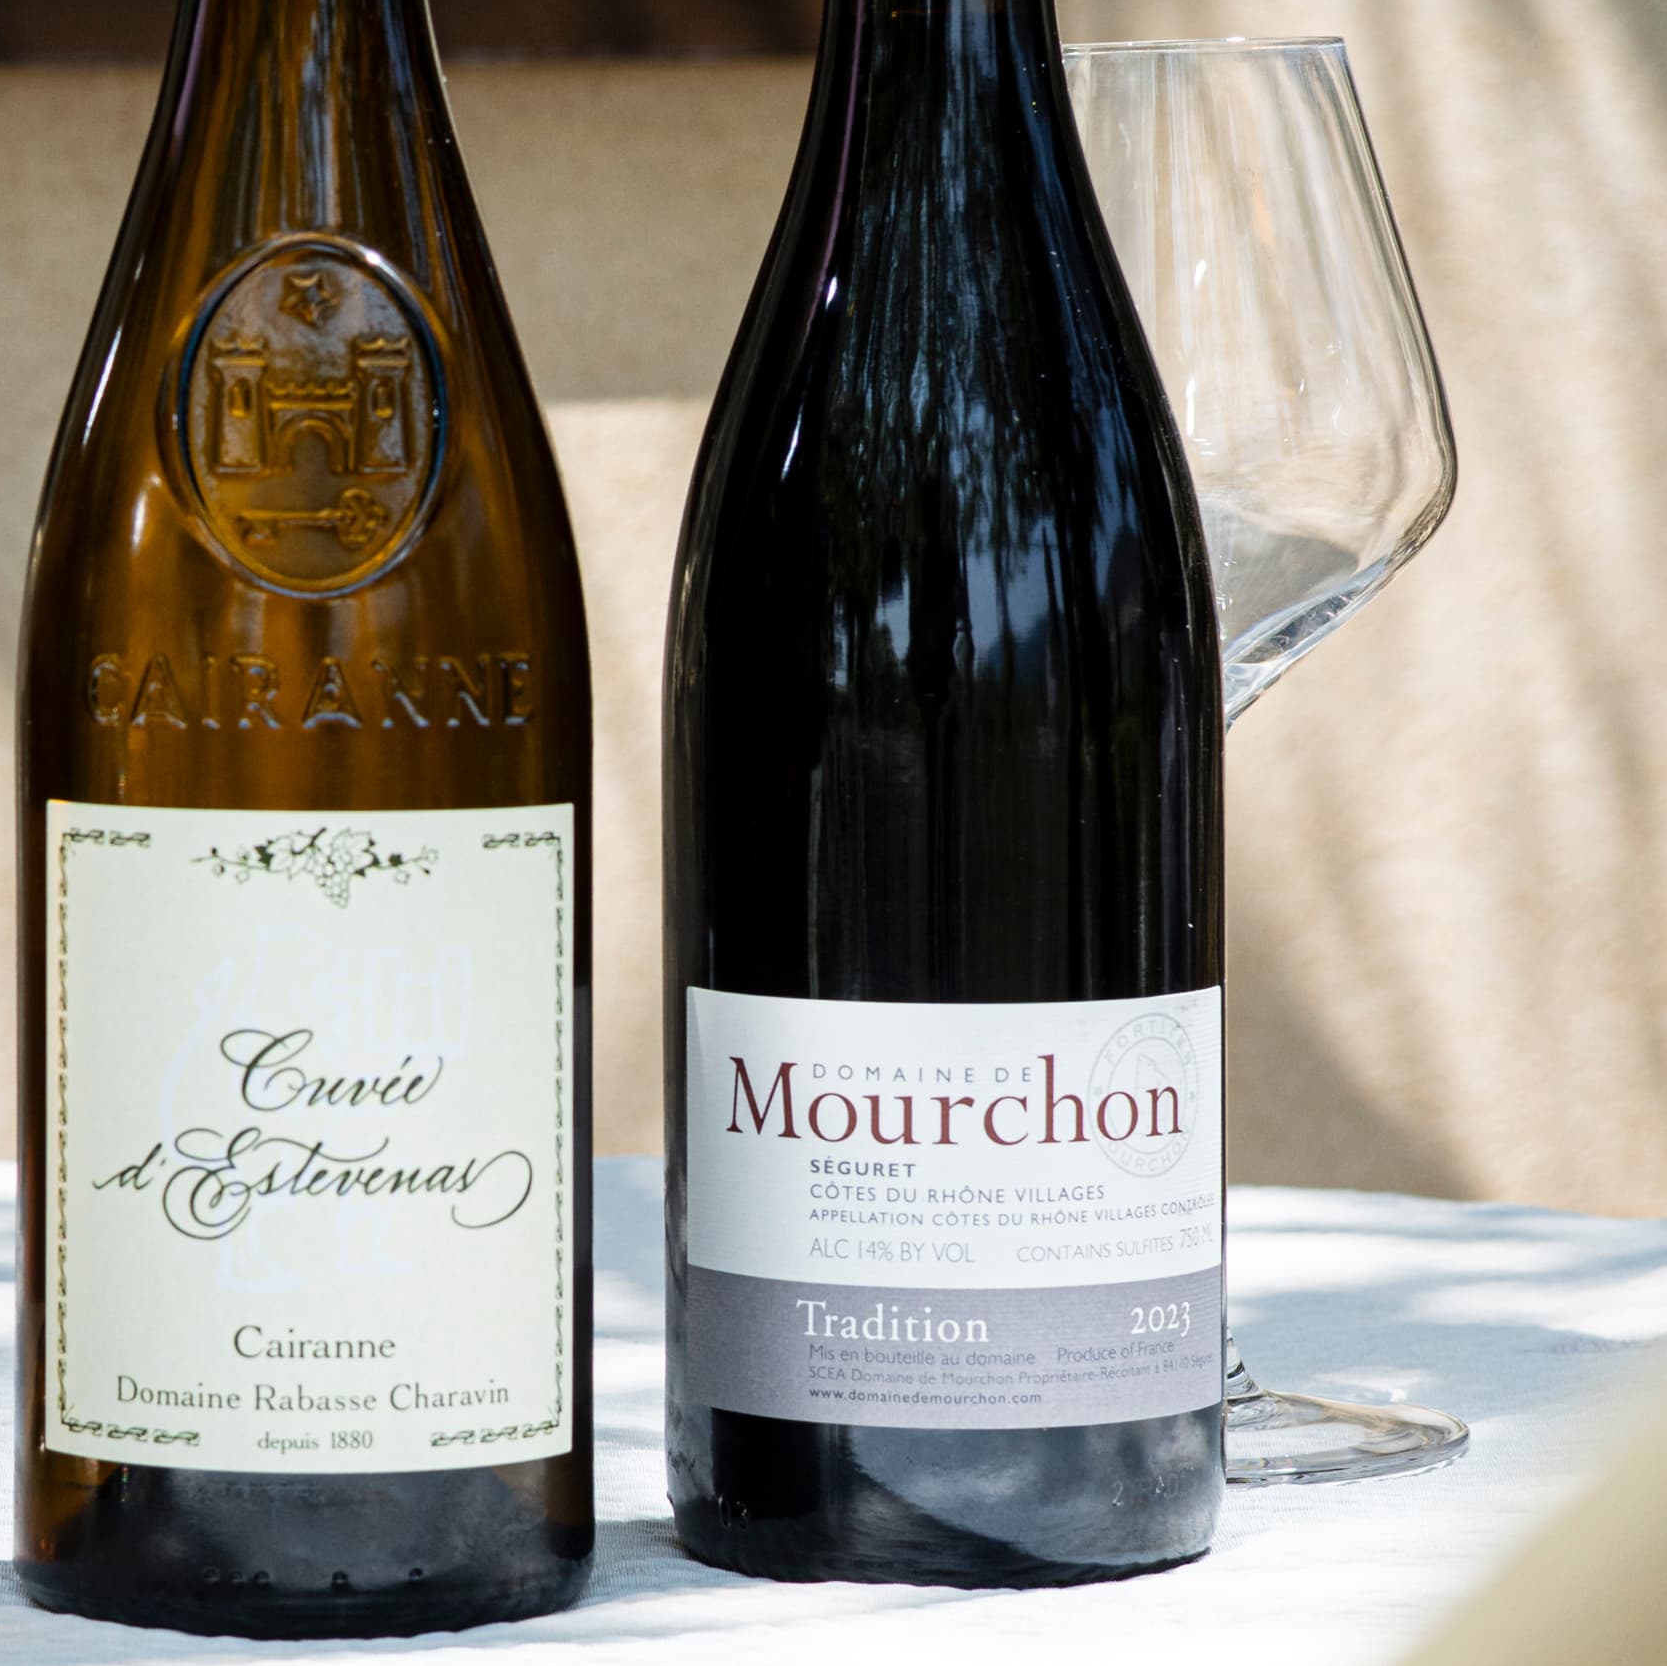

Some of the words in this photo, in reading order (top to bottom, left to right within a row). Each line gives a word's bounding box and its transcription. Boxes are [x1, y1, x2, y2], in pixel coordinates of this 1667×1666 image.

[87, 652, 531, 729] CAIRANNE
[220, 1029, 444, 1112] Cuvée
[812, 1062, 974, 1084] DOMAINE
[994, 1065, 1033, 1084] DE
[726, 1053, 1183, 1146] Mourchon
[810, 1155, 917, 1178] SÉGURET
[810, 1181, 877, 1202] CÔTES
[886, 1187, 918, 1203] DU
[928, 1185, 1005, 1204] RHÔNE
[1015, 1185, 1106, 1203] VILLAGES
[809, 1208, 924, 1226] APPELLATION
[932, 1210, 991, 1227] CÔTES
[998, 1213, 1023, 1227] DU
[1030, 1209, 1088, 1226] RHÔNE
[1095, 1204, 1157, 1222] VILLAGES
[809, 1237, 850, 1259] ALC
[858, 1240, 894, 1262] 14%
[900, 1241, 927, 1263] BY
[931, 1242, 976, 1264] VOL
[1016, 1242, 1111, 1264] CONTAINS
[1116, 1235, 1174, 1257] SULFITES
[1180, 1226, 1200, 1250] 750
[796, 1299, 989, 1343] Tradition
[1131, 1301, 1191, 1337] 2023
[233, 1324, 397, 1360] Cairanne
[1057, 1343, 1117, 1363] Produce
[1120, 1343, 1135, 1359] of
[1137, 1340, 1175, 1357] France
[809, 1343, 835, 1361] Mis
[840, 1349, 859, 1362] en
[864, 1347, 934, 1365] bouteille
[941, 1352, 960, 1366] au
[965, 1351, 1036, 1367] domaine
[809, 1366, 846, 1381] SCEA
[851, 1368, 913, 1384] Domaine
[919, 1370, 936, 1385] de
[942, 1370, 1013, 1386] Mourchon
[116, 1375, 242, 1411] Domaine
[254, 1383, 378, 1412] Rabasse
[389, 1377, 510, 1411] Charavin
[809, 1387, 1042, 1406] www.domainedemourchon.com
[257, 1431, 319, 1453] depuis
[331, 1429, 374, 1450] 1880
